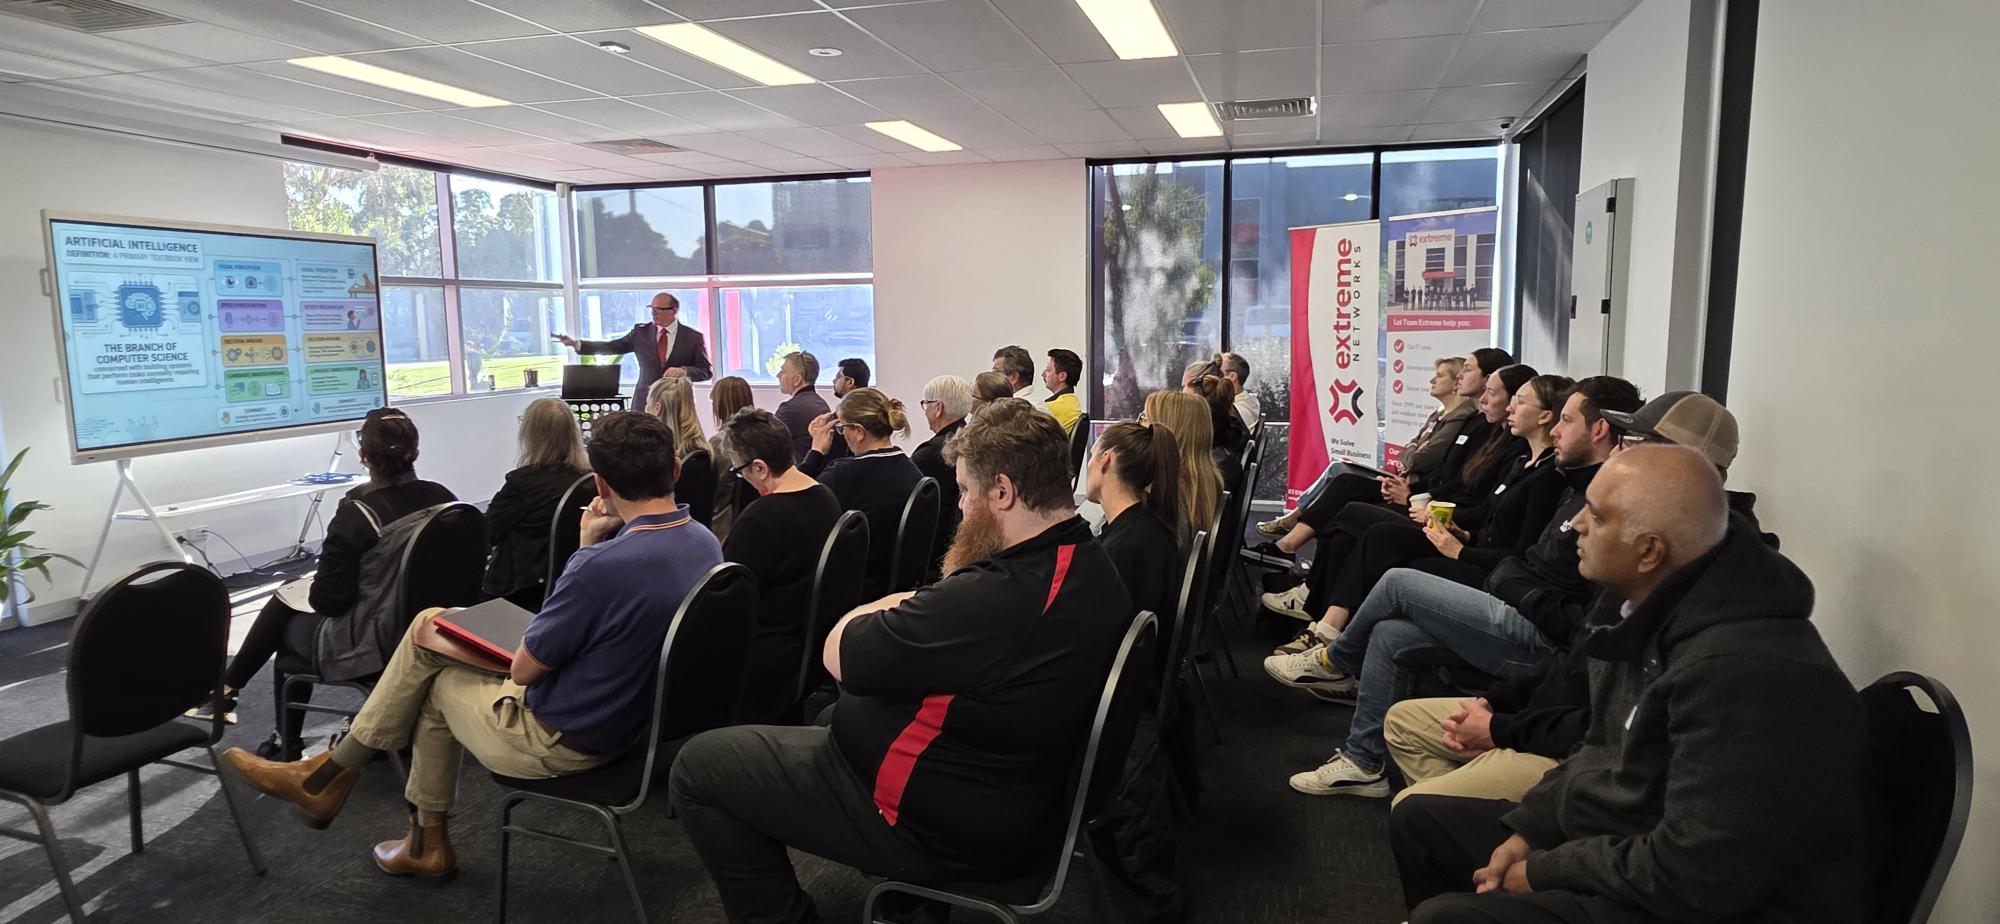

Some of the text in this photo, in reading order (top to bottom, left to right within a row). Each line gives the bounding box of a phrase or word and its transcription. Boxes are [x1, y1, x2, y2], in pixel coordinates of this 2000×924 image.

[1419, 234, 1452, 243] extreme
[65, 236, 198, 253] ARTIFICIAL INTELLIGENCE
[1333, 238, 1352, 369] extreme
[1353, 246, 1361, 362] NETWORKS
[1442, 319, 1457, 327] help
[104, 342, 177, 352] THE BRANCH OF
[96, 352, 189, 364] COMPUTER SCIENCE
[1340, 439, 1355, 447] Solve
[1347, 450, 1371, 459] Business
